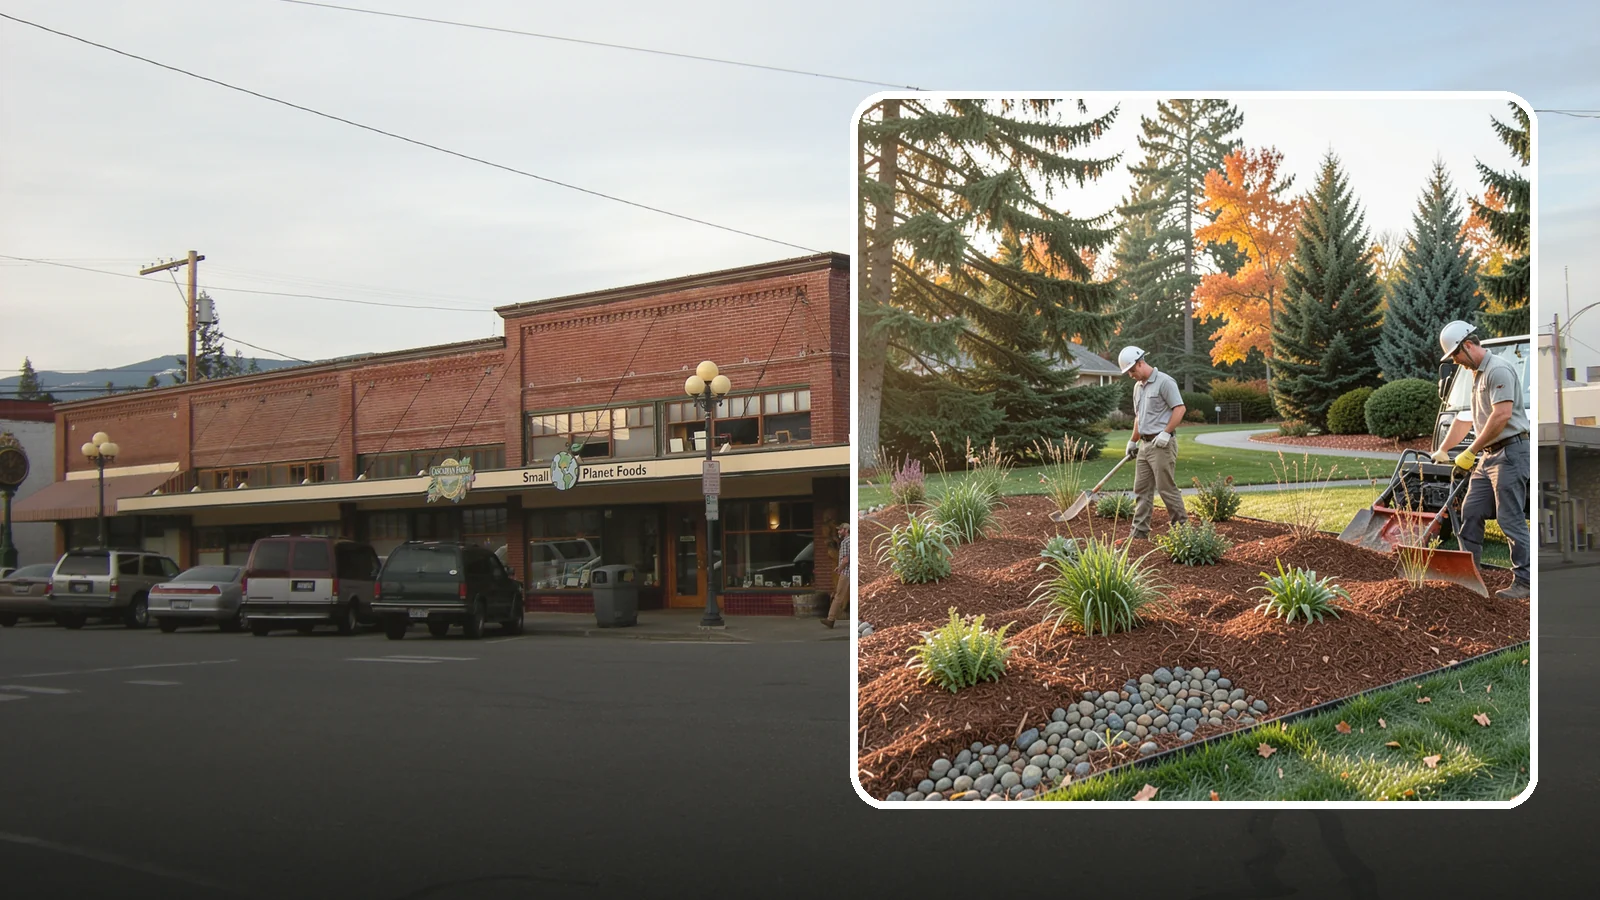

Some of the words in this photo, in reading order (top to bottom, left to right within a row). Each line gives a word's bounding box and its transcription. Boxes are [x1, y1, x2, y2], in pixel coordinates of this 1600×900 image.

[523, 471, 549, 482] Small
[583, 467, 614, 479] Planet
[617, 464, 647, 477] Foods
